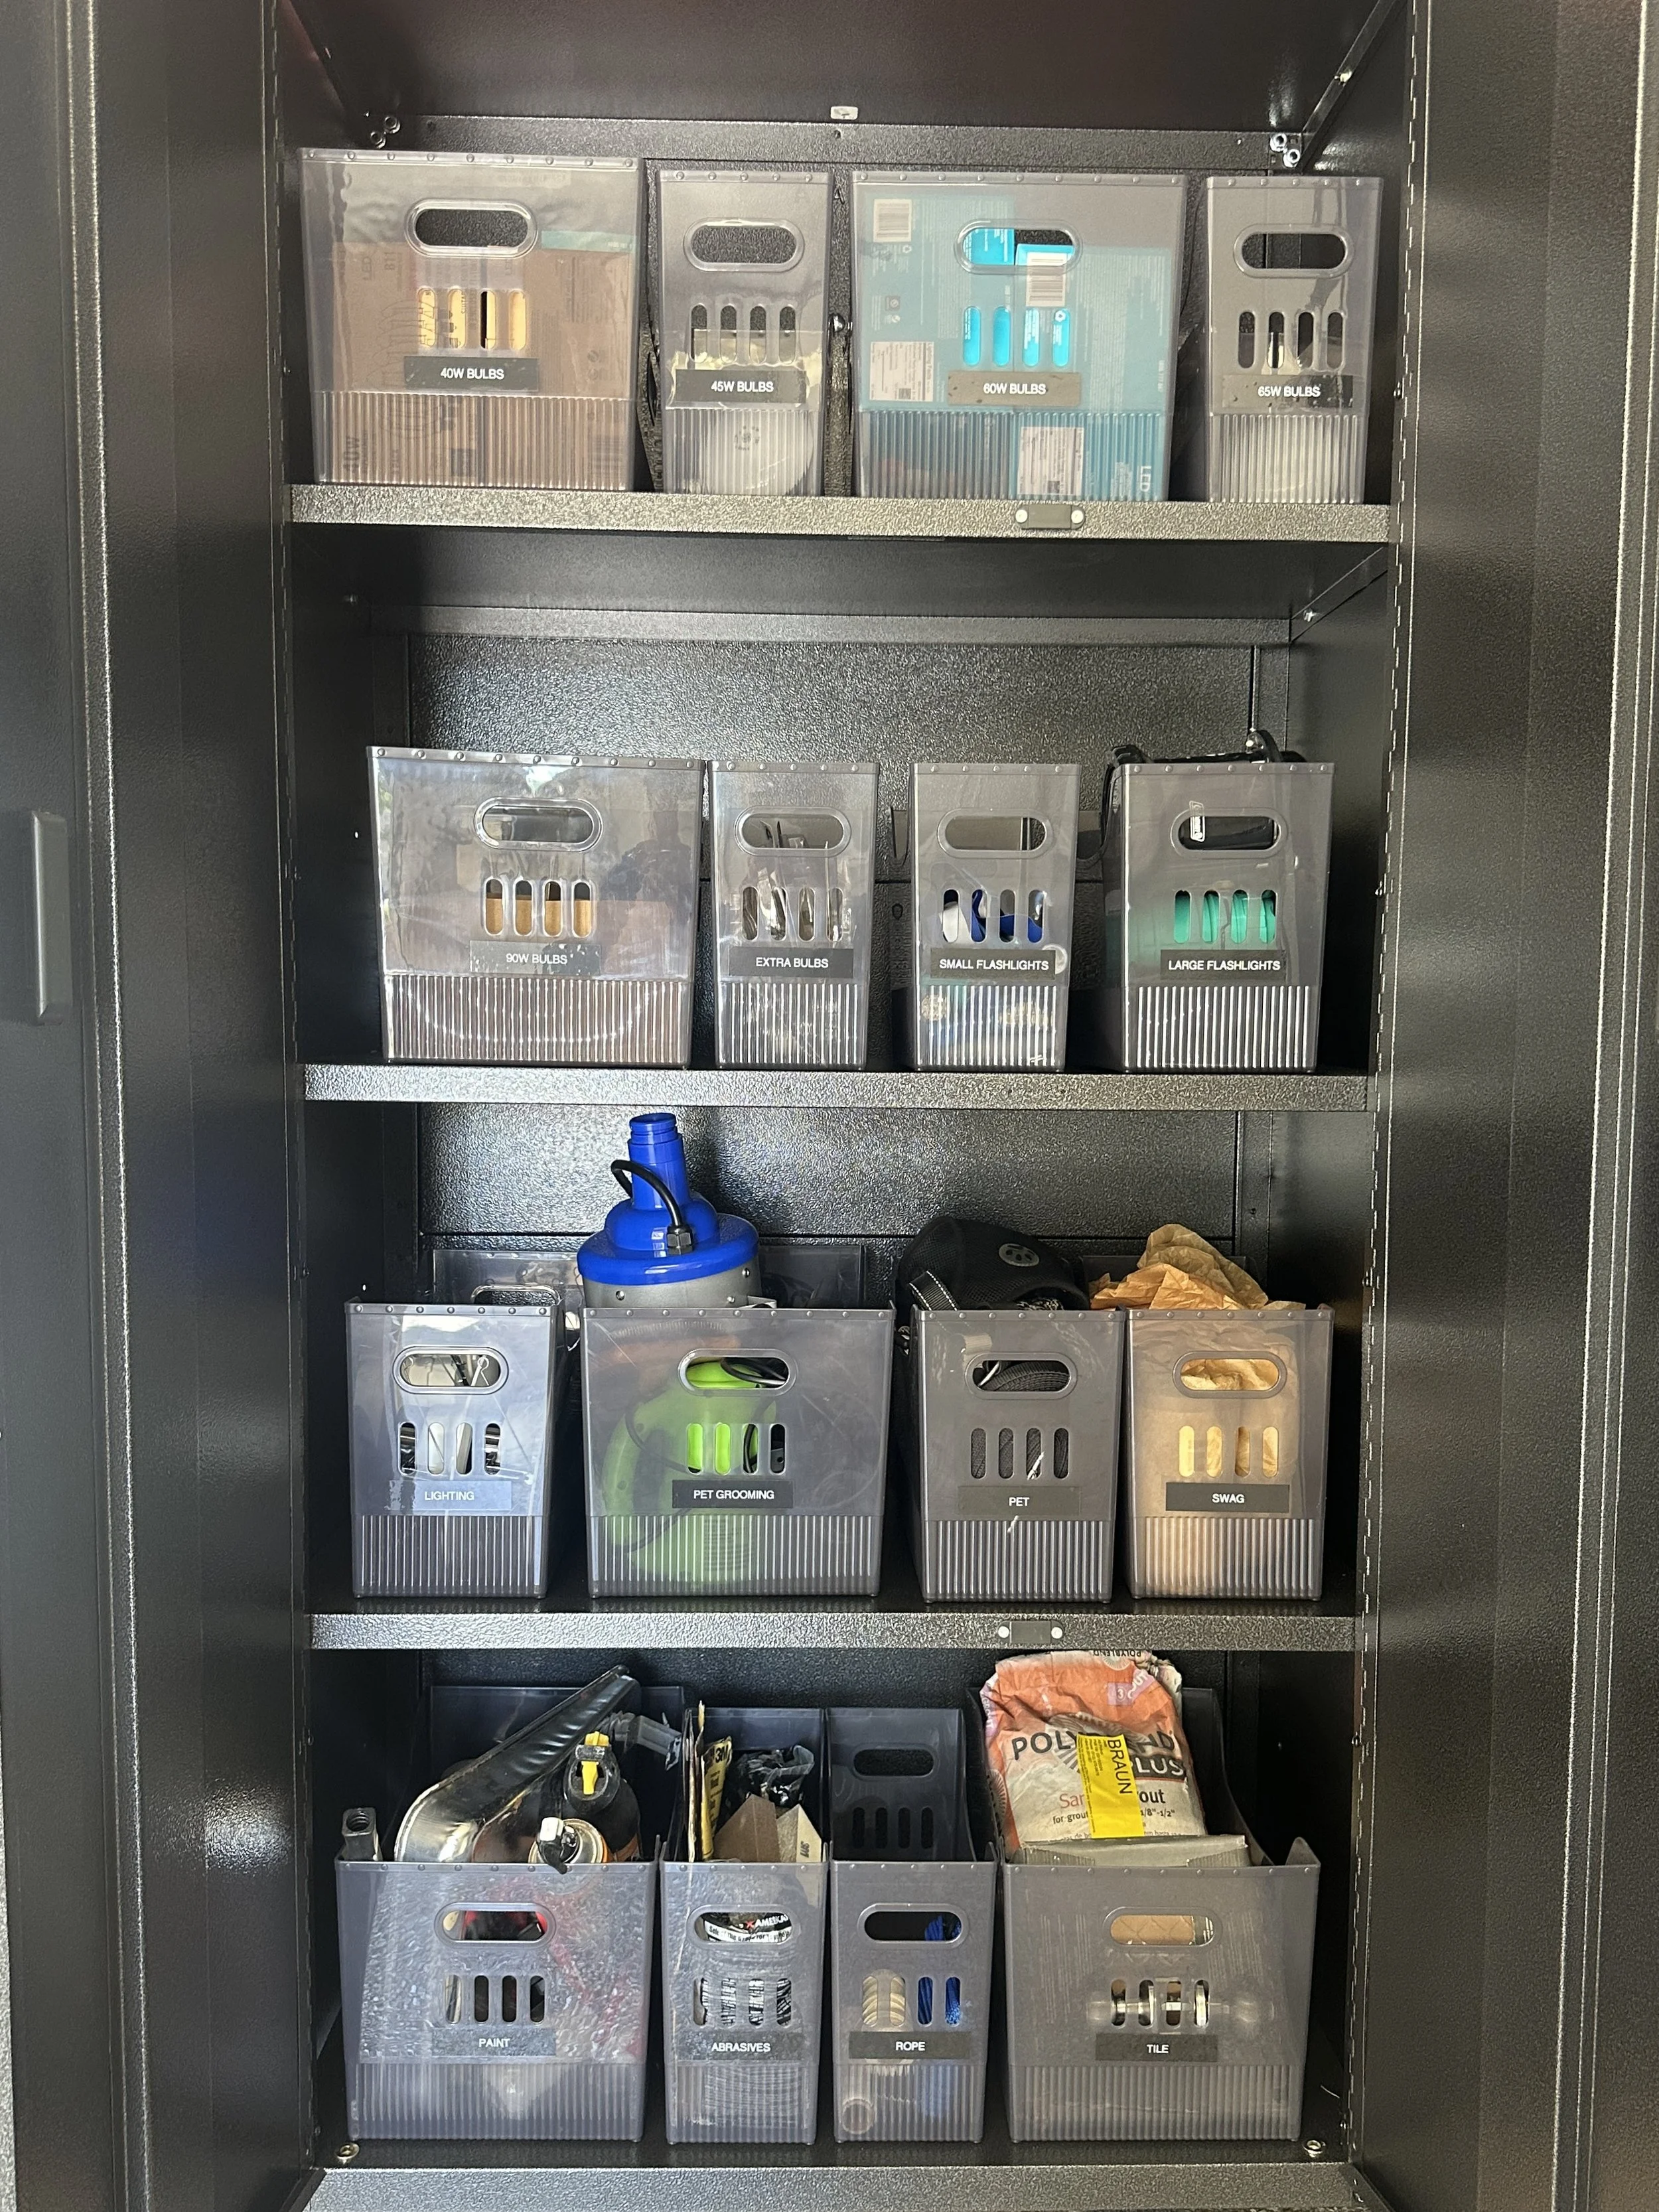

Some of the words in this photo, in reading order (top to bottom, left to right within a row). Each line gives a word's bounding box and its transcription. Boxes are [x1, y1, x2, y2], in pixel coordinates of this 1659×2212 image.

[440, 367, 465, 379] 40W
[467, 368, 505, 380] BULBS
[711, 380, 735, 392] 45W
[737, 381, 774, 393] BULBS
[983, 382, 1007, 394] 60W
[1009, 383, 1046, 395] BULBS
[1258, 386, 1282, 397] 65W
[1283, 386, 1321, 398] BULBS
[1139, 465, 1152, 492] LED
[506, 953, 530, 963] 90W
[532, 954, 567, 965] BULBS
[756, 957, 792, 968] EXTRA
[793, 958, 829, 968] BULBS
[939, 958, 974, 970] SMALL
[976, 959, 1049, 971] FLASHLIGHTS
[1168, 960, 1204, 970] LARGE
[1206, 960, 1281, 971] FLASHLIGHTS
[424, 1491, 474, 1501] LIGHTING
[693, 1489, 714, 1499] PET
[715, 1489, 774, 1500] GROOMING
[1212, 1493, 1245, 1504] SWAG
[1009, 1497, 1030, 1507] PET
[1108, 1739, 1133, 1794] BRAUN
[1131, 1757, 1185, 1776] LUS
[1052, 1816, 1064, 1824] for
[478, 2038, 510, 2048] PAINT
[711, 2042, 771, 2053] ABRASIVES
[895, 2041, 926, 2051] ROPE
[1146, 2044, 1169, 2053] TILE
